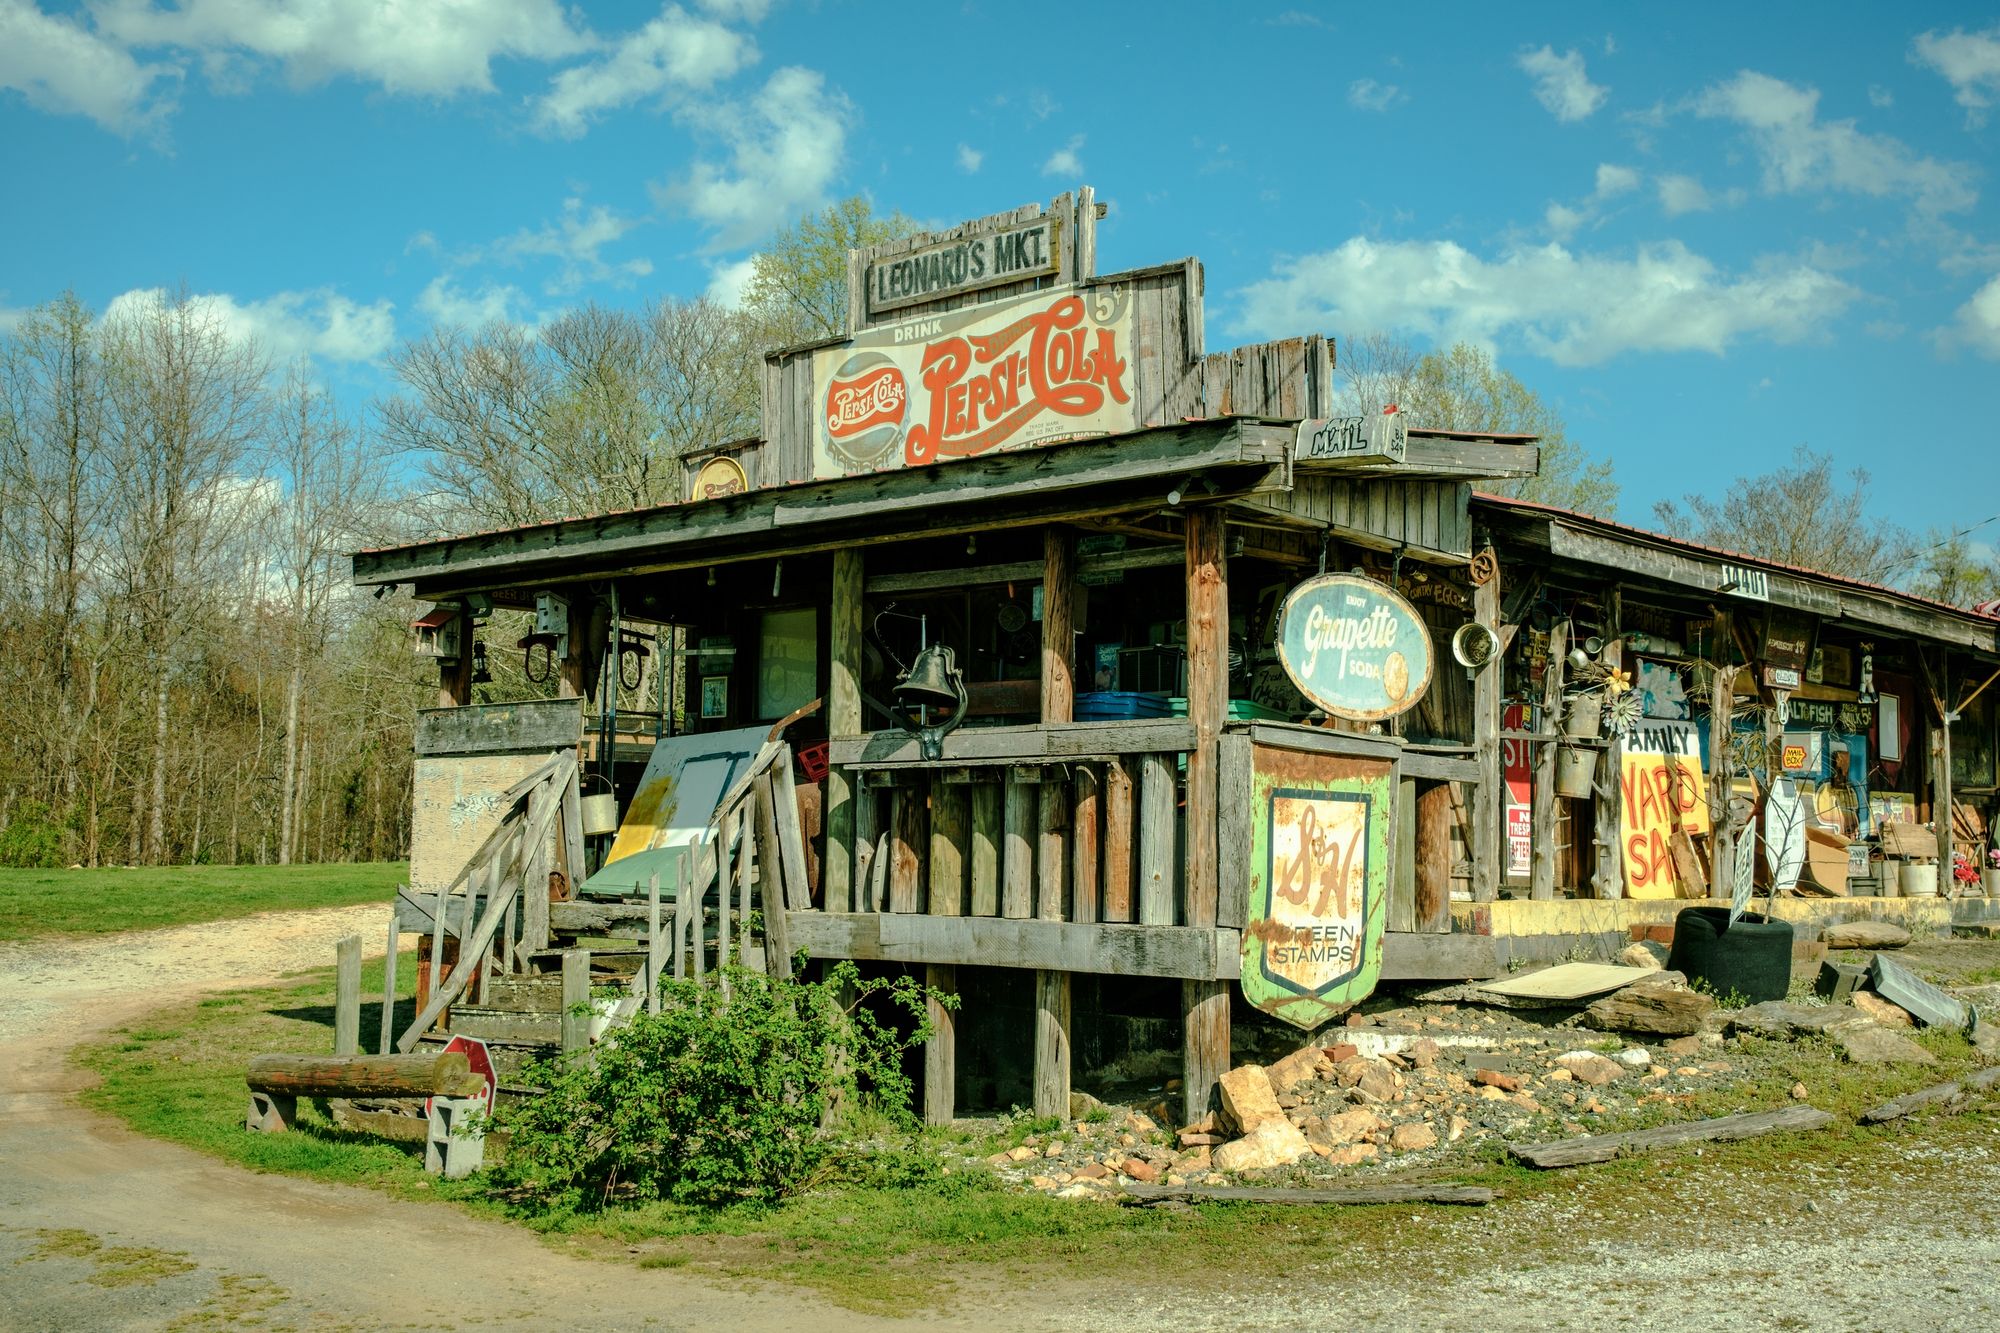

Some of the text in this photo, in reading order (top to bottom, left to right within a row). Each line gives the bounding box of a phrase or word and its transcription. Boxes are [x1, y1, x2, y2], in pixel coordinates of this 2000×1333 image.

[878, 226, 1048, 299] LEONARD'S MKT.
[1094, 283, 1124, 324] 5¢
[894, 321, 943, 344] DRINK
[1311, 427, 1368, 456] MAIL
[1346, 594, 1367, 608] ENJOY
[1301, 603, 1399, 680] Grapette
[1349, 659, 1381, 681] SODA
[1809, 703, 1833, 726] FISH
[1621, 725, 1690, 755] AMILY
[1786, 749, 1804, 758] MAIL
[1786, 757, 1801, 766] BOX
[1621, 761, 1697, 830] YARD
[1276, 945, 1354, 964] STAMPS
